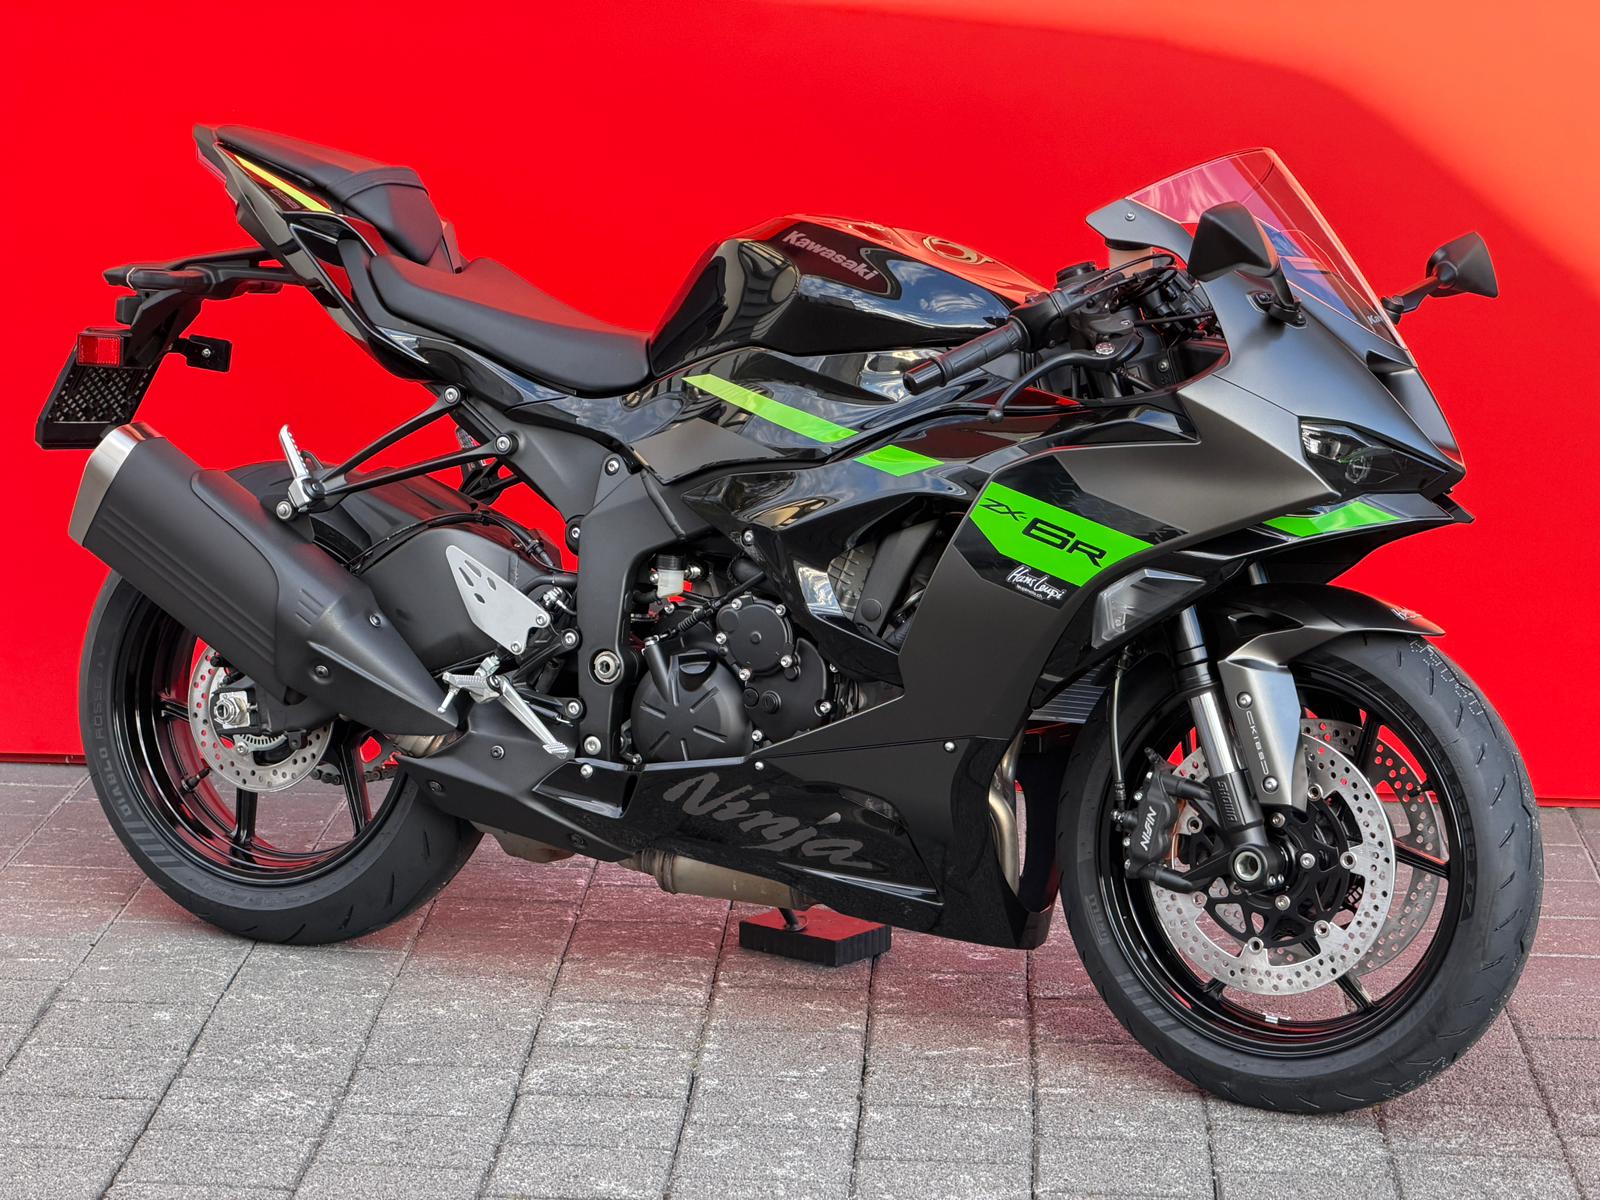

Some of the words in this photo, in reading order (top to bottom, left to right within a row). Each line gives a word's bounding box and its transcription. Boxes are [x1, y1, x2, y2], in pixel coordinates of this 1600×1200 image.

[782, 230, 880, 281] Kawasaki
[978, 497, 1107, 568] ZX-6R
[1007, 564, 1034, 587] Hans
[98, 746, 132, 819] DIABLO
[662, 772, 873, 869] Ninja
[1140, 806, 1158, 852] NISSIN
